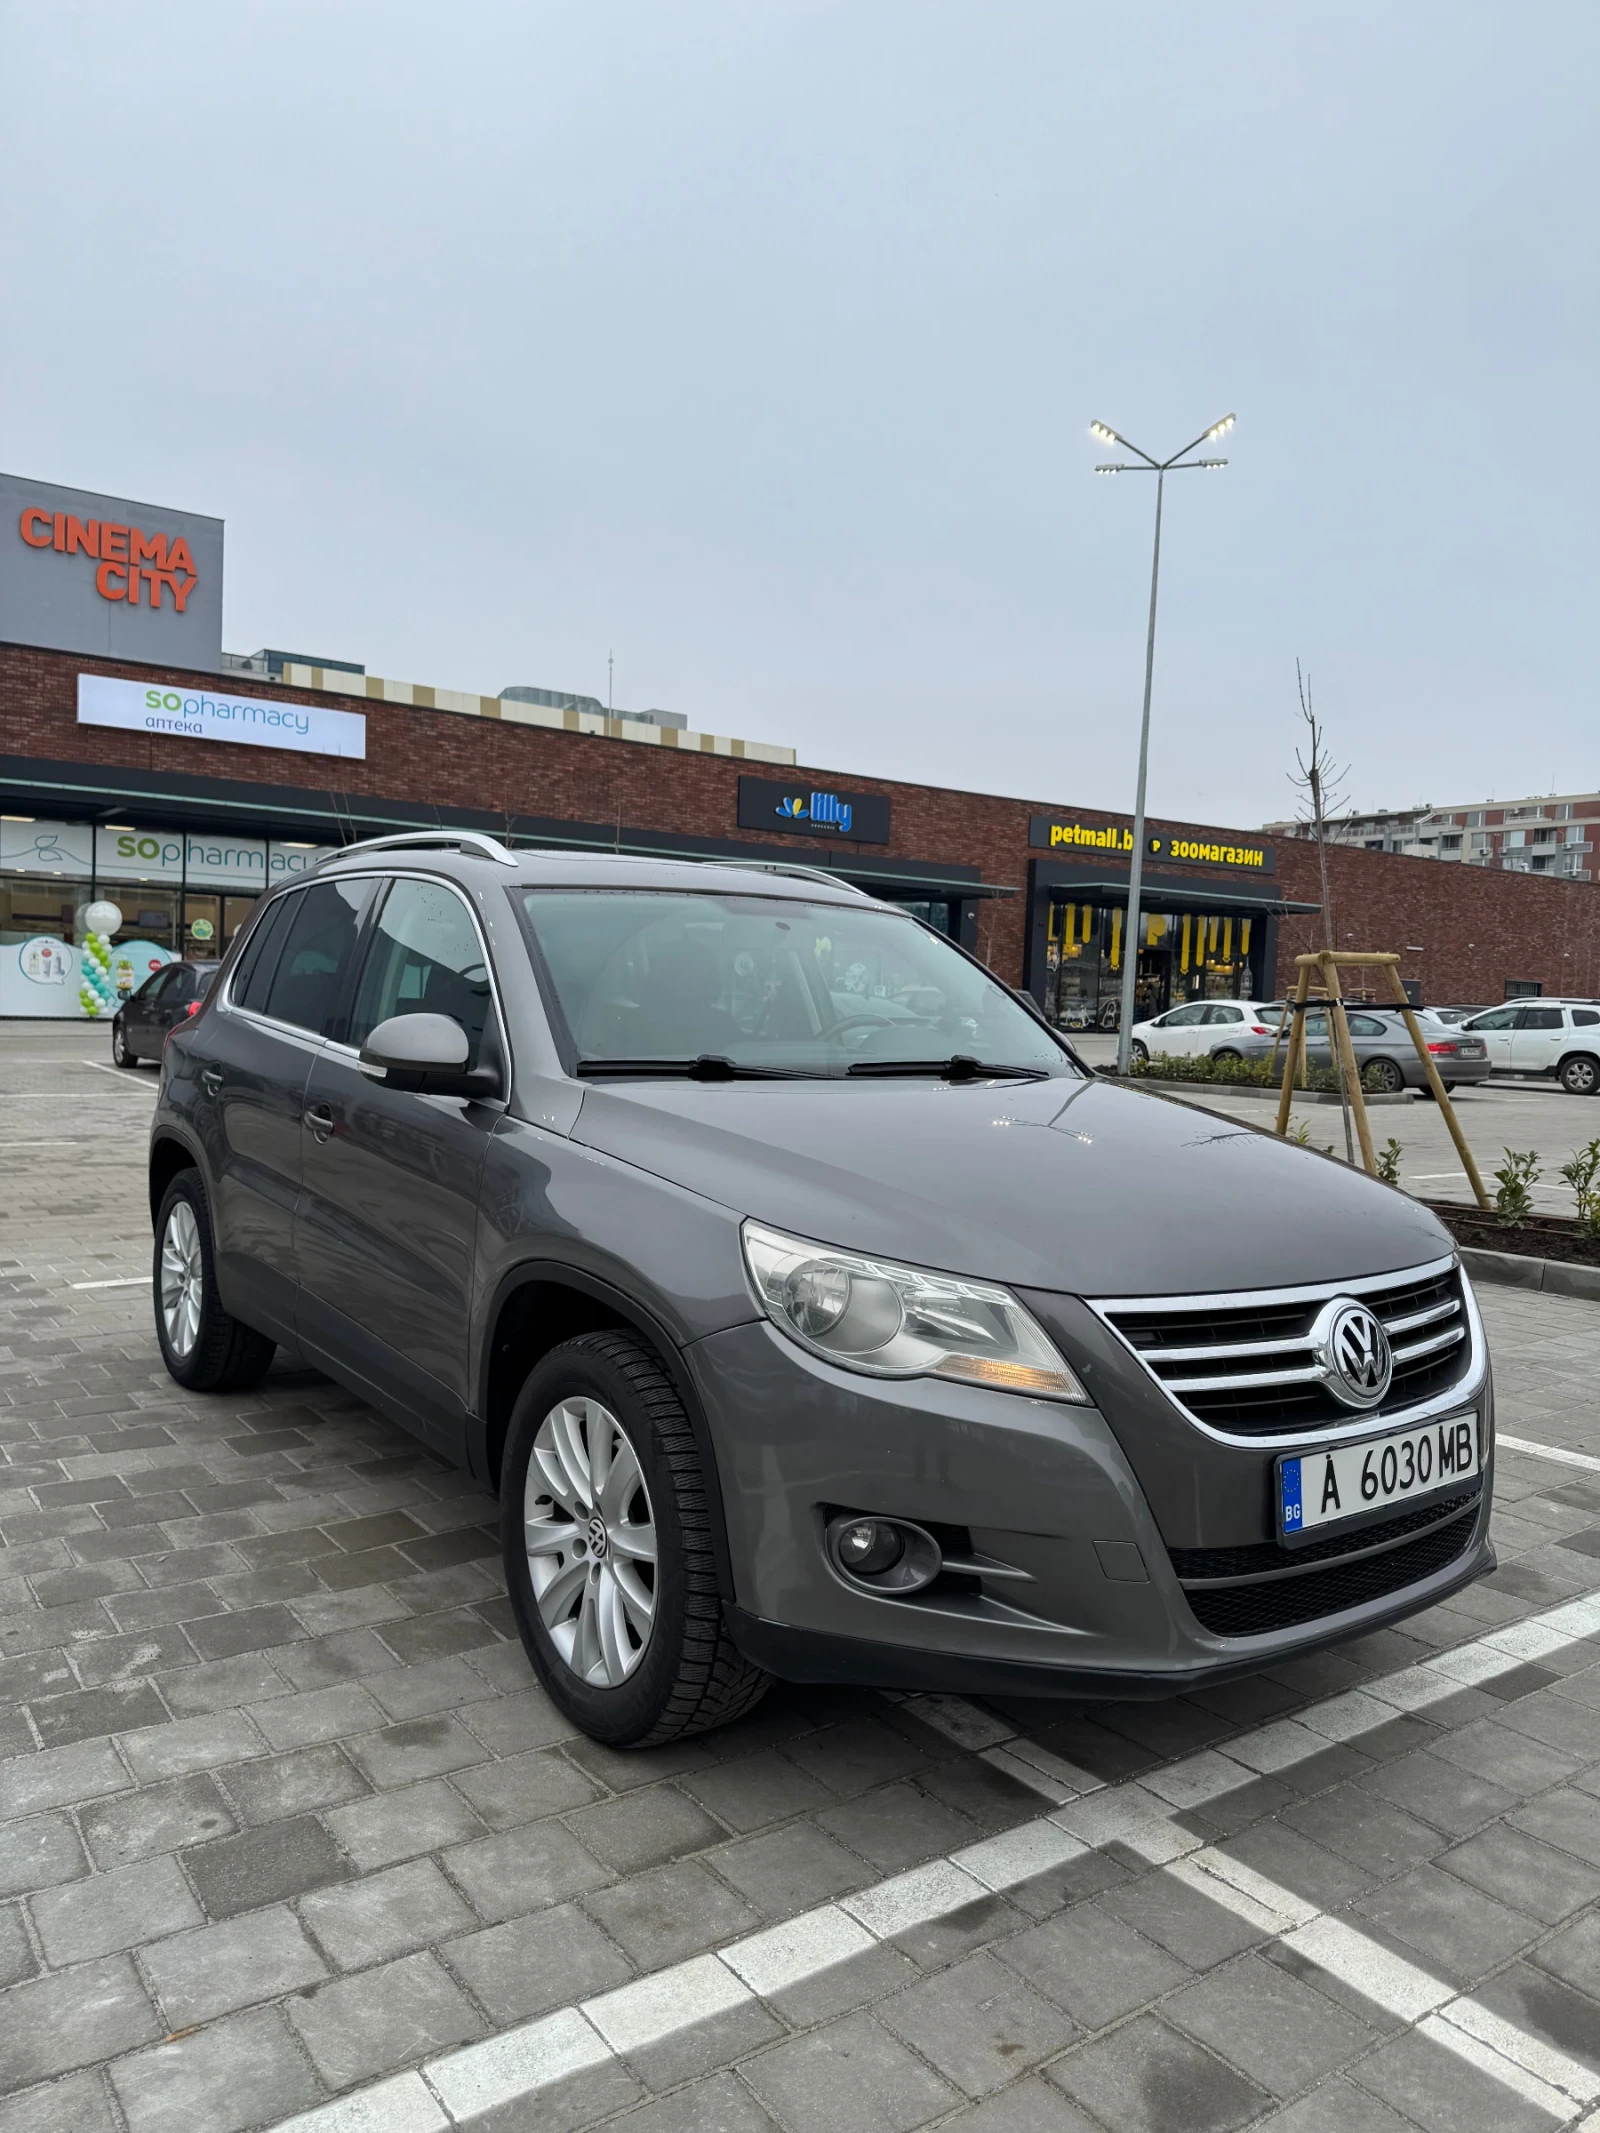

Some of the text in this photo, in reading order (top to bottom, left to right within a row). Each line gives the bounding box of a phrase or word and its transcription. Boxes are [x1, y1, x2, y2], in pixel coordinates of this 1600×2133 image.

[20, 507, 198, 577] CINEMA
[96, 562, 198, 612] CITY
[145, 690, 309, 735] sopharmacy
[145, 716, 204, 735] аптека
[810, 792, 852, 832] lilly
[1050, 824, 1134, 851] petmall.b
[1170, 840, 1263, 866] зоомагазин
[1321, 1423, 1473, 1514] A 6030 MB
[1285, 1503, 1301, 1522] BG
